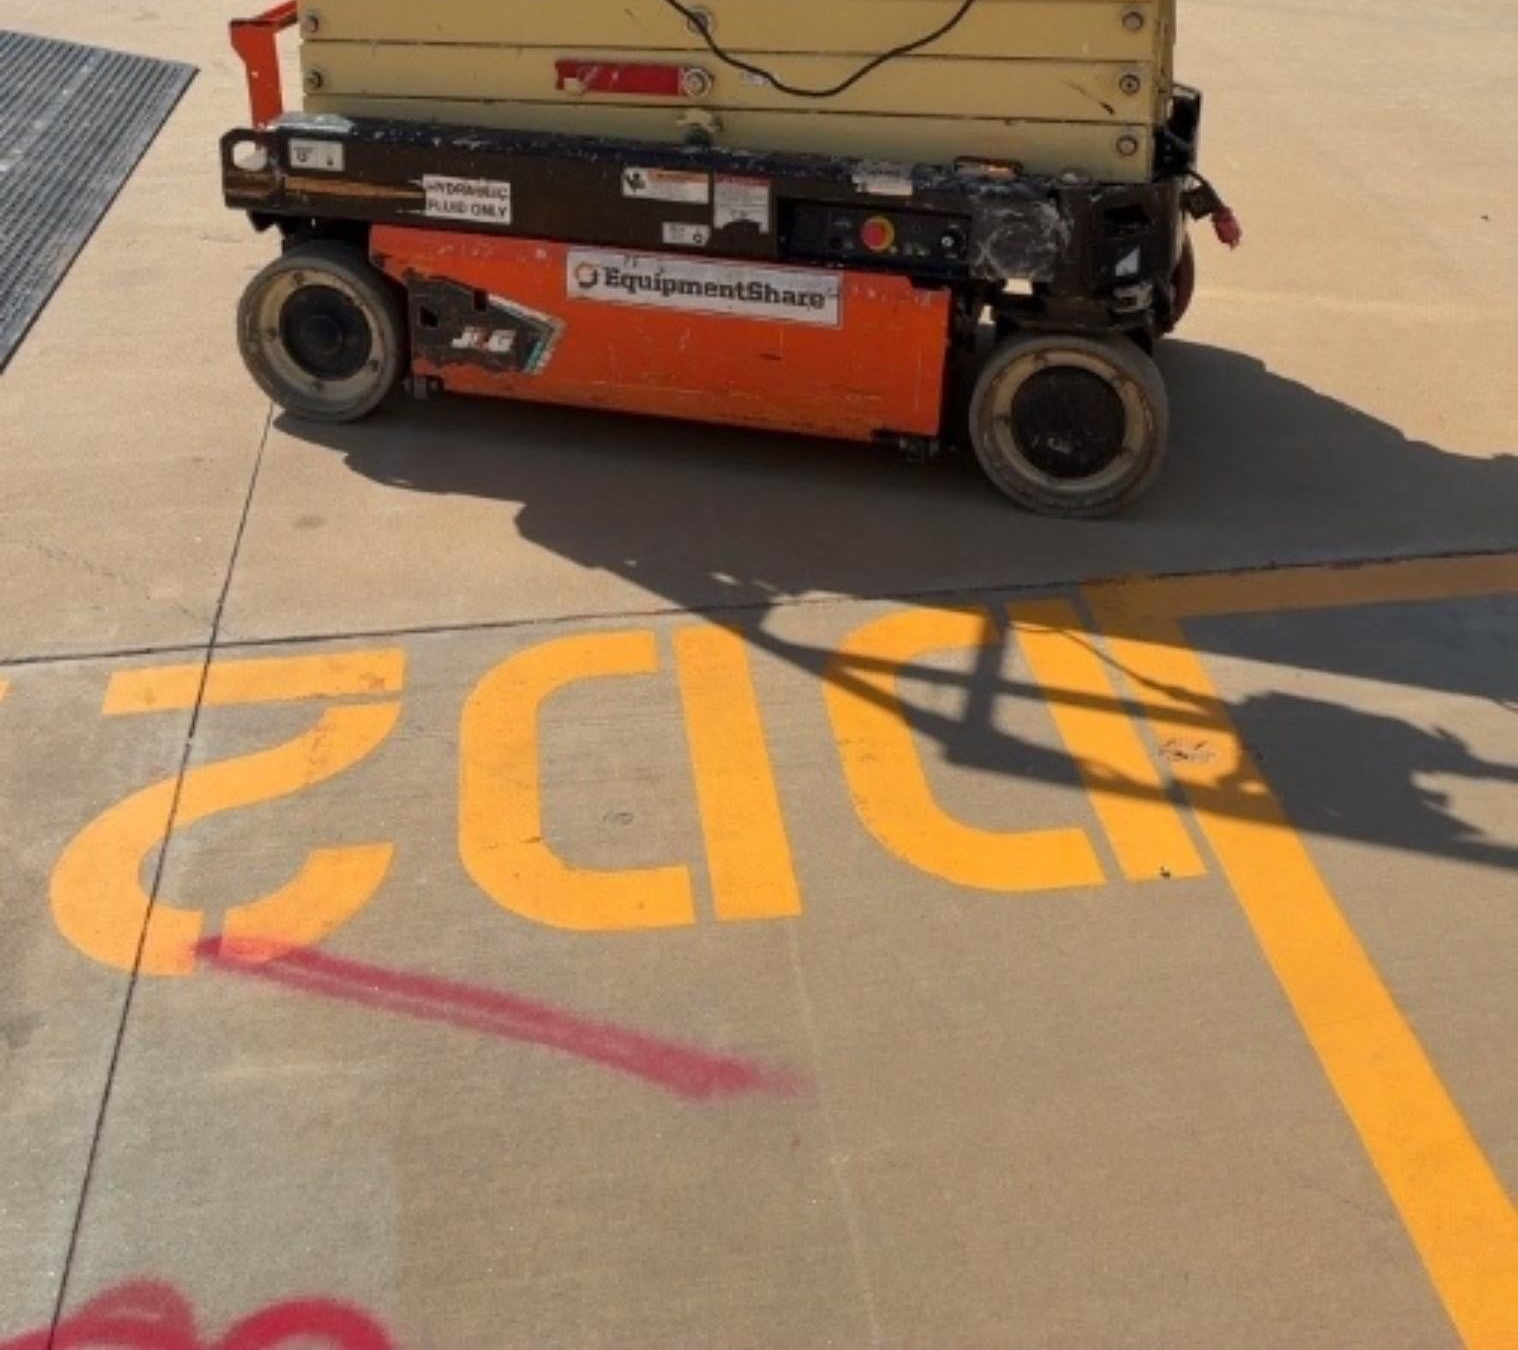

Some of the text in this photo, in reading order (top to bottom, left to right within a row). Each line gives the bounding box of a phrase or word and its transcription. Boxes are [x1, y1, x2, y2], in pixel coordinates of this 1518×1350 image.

[603, 265, 826, 310] EquipmentShare
[451, 325, 517, 352] JLG
[0, 596, 1208, 978] DD2
